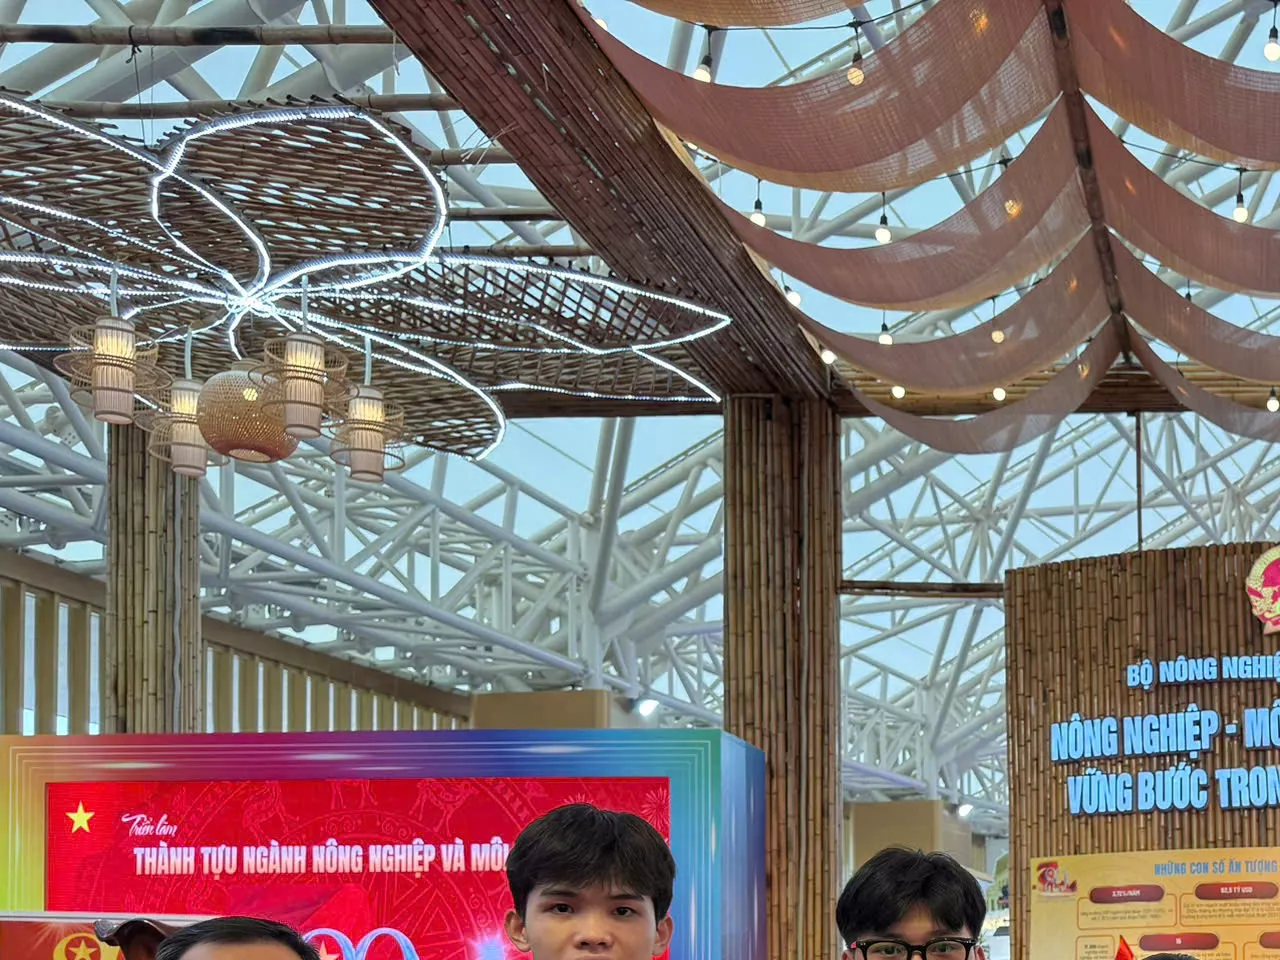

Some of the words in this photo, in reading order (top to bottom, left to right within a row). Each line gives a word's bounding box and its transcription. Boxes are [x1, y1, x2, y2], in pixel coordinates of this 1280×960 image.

[1127, 658, 1153, 691] BỘ
[1159, 655, 1218, 683] NÔNG
[1051, 713, 1118, 761] NÔNG
[1123, 703, 1220, 759] NGHIỆP
[1067, 767, 1133, 815] VỮNG
[1138, 762, 1208, 811] BƯỚC
[134, 840, 195, 875] THÀNH
[201, 843, 238, 881] TỰU
[243, 839, 306, 874] NGÀNH
[312, 838, 364, 874] NÔNG
[369, 838, 435, 879] NGHIỆP
[440, 838, 466, 872] VÀ
[1154, 860, 1186, 876] NHỮNG
[1190, 862, 1209, 874] CON
[1212, 858, 1225, 874] SỐ
[1228, 857, 1242, 873] ẤN
[1245, 859, 1277, 875] TƯỢNG
